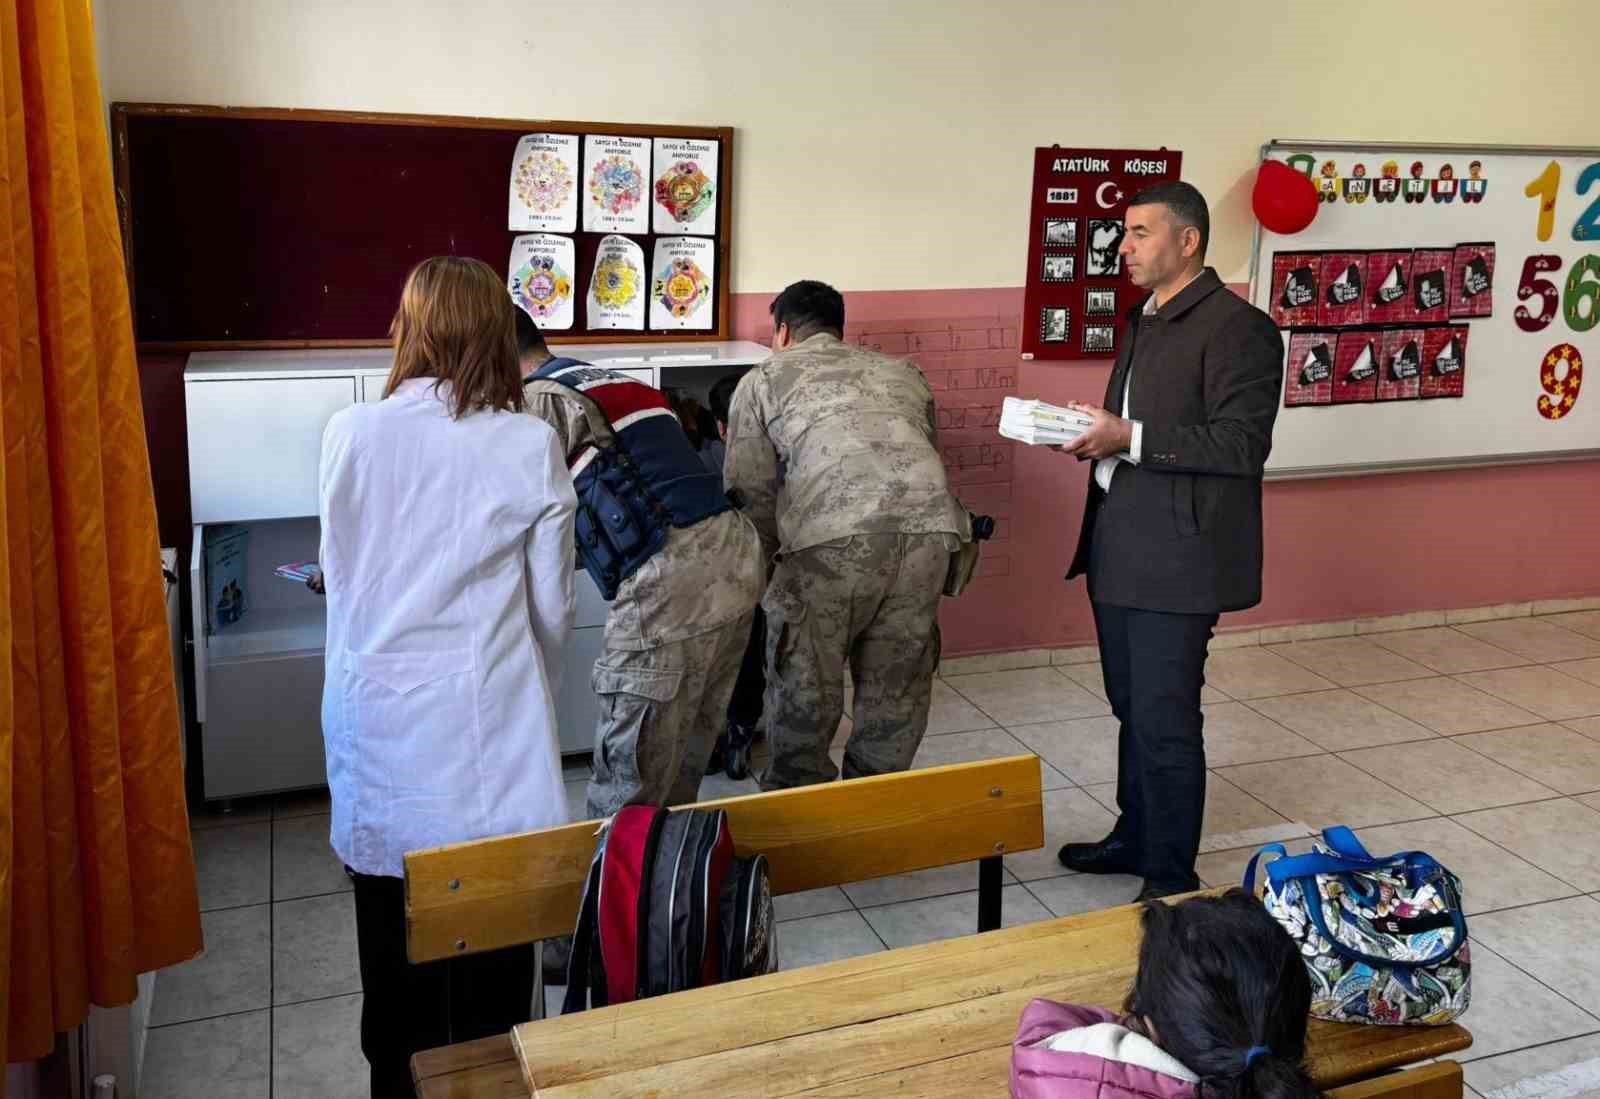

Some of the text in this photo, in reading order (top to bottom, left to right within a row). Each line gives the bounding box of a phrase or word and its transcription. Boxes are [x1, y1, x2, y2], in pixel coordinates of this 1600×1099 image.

[1050, 191, 1075, 201] 1881
[1052, 157, 1167, 175] ATATÜRK KÖŞESİ
[1524, 160, 1600, 241] 1 2
[1514, 254, 1600, 332] 5 6
[1537, 343, 1583, 421] 9
